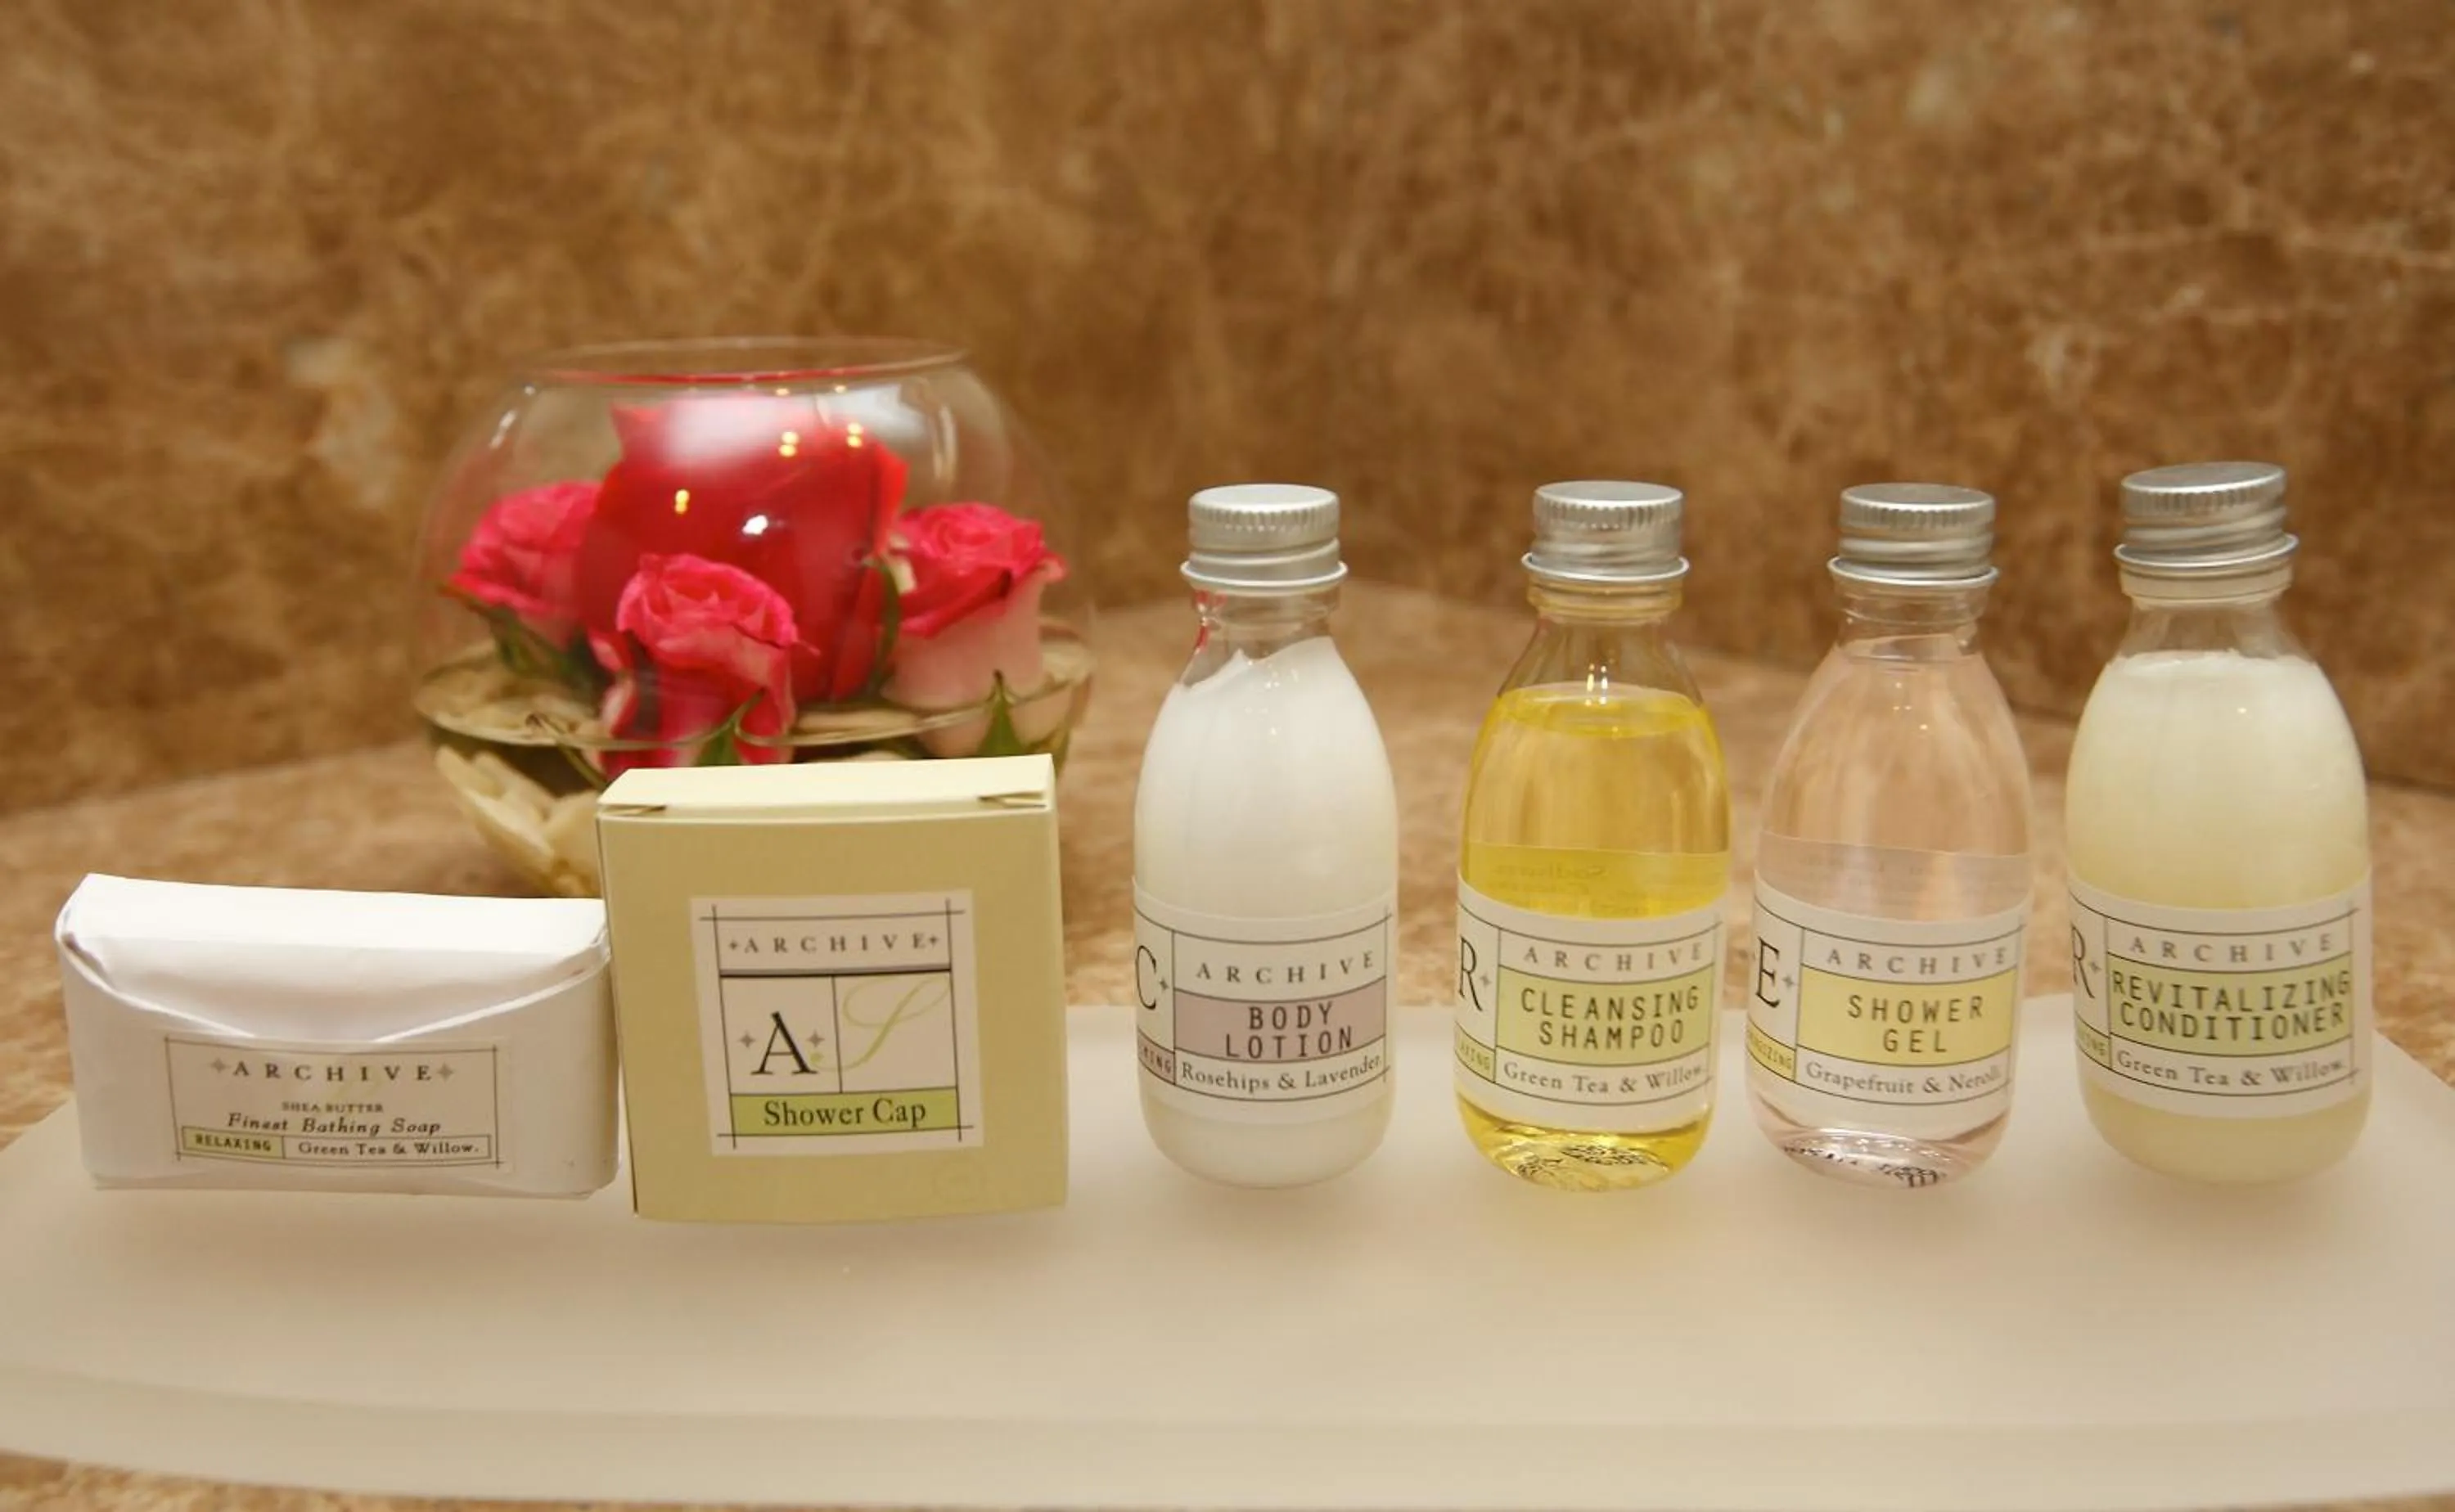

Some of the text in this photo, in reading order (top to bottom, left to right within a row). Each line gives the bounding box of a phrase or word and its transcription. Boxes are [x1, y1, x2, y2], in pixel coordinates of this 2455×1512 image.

[744, 934, 927, 954] ARCHIVE
[1525, 942, 1702, 972] ARCHIVE
[2131, 933, 2332, 963] ARCHIVE
[1196, 950, 1374, 984] ARCHIVE
[1458, 936, 1483, 1012] R
[1755, 936, 1780, 1009] E
[1827, 947, 2007, 974] ARCHIVE
[1521, 985, 1699, 1021] CLEANSING
[2112, 970, 2350, 1012] REVITALIZING
[1249, 1001, 1332, 1031] BODY
[1847, 995, 1984, 1023] SHOWER
[2120, 1001, 2344, 1041] CONDITIONER
[750, 1010, 818, 1075] A
[1227, 1025, 1352, 1059] LOTION
[1538, 1019, 1683, 1050] SHAMPOO
[1883, 1028, 1948, 1053] GEL
[232, 1061, 432, 1082] ARCHIVE
[1182, 1055, 1380, 1093] Rosehips & Lavender
[1503, 1061, 1563, 1090] Green
[1572, 1074, 1609, 1094] Tea
[1619, 1078, 1637, 1093] &
[1805, 1061, 1914, 1094] Grapefruit
[1922, 1077, 1942, 1094] &
[2117, 1050, 2178, 1080] Green
[2188, 1066, 2229, 1086] Tea
[2241, 1070, 2261, 1086] &
[282, 1101, 385, 1113] SHEA BUTTER
[764, 1097, 926, 1127] Shower Cap
[228, 1112, 441, 1137] Finest Bathing Soap
[196, 1133, 271, 1152] RELAXING
[298, 1141, 349, 1155] Green
[358, 1143, 385, 1155] Tea
[393, 1144, 407, 1154] &
